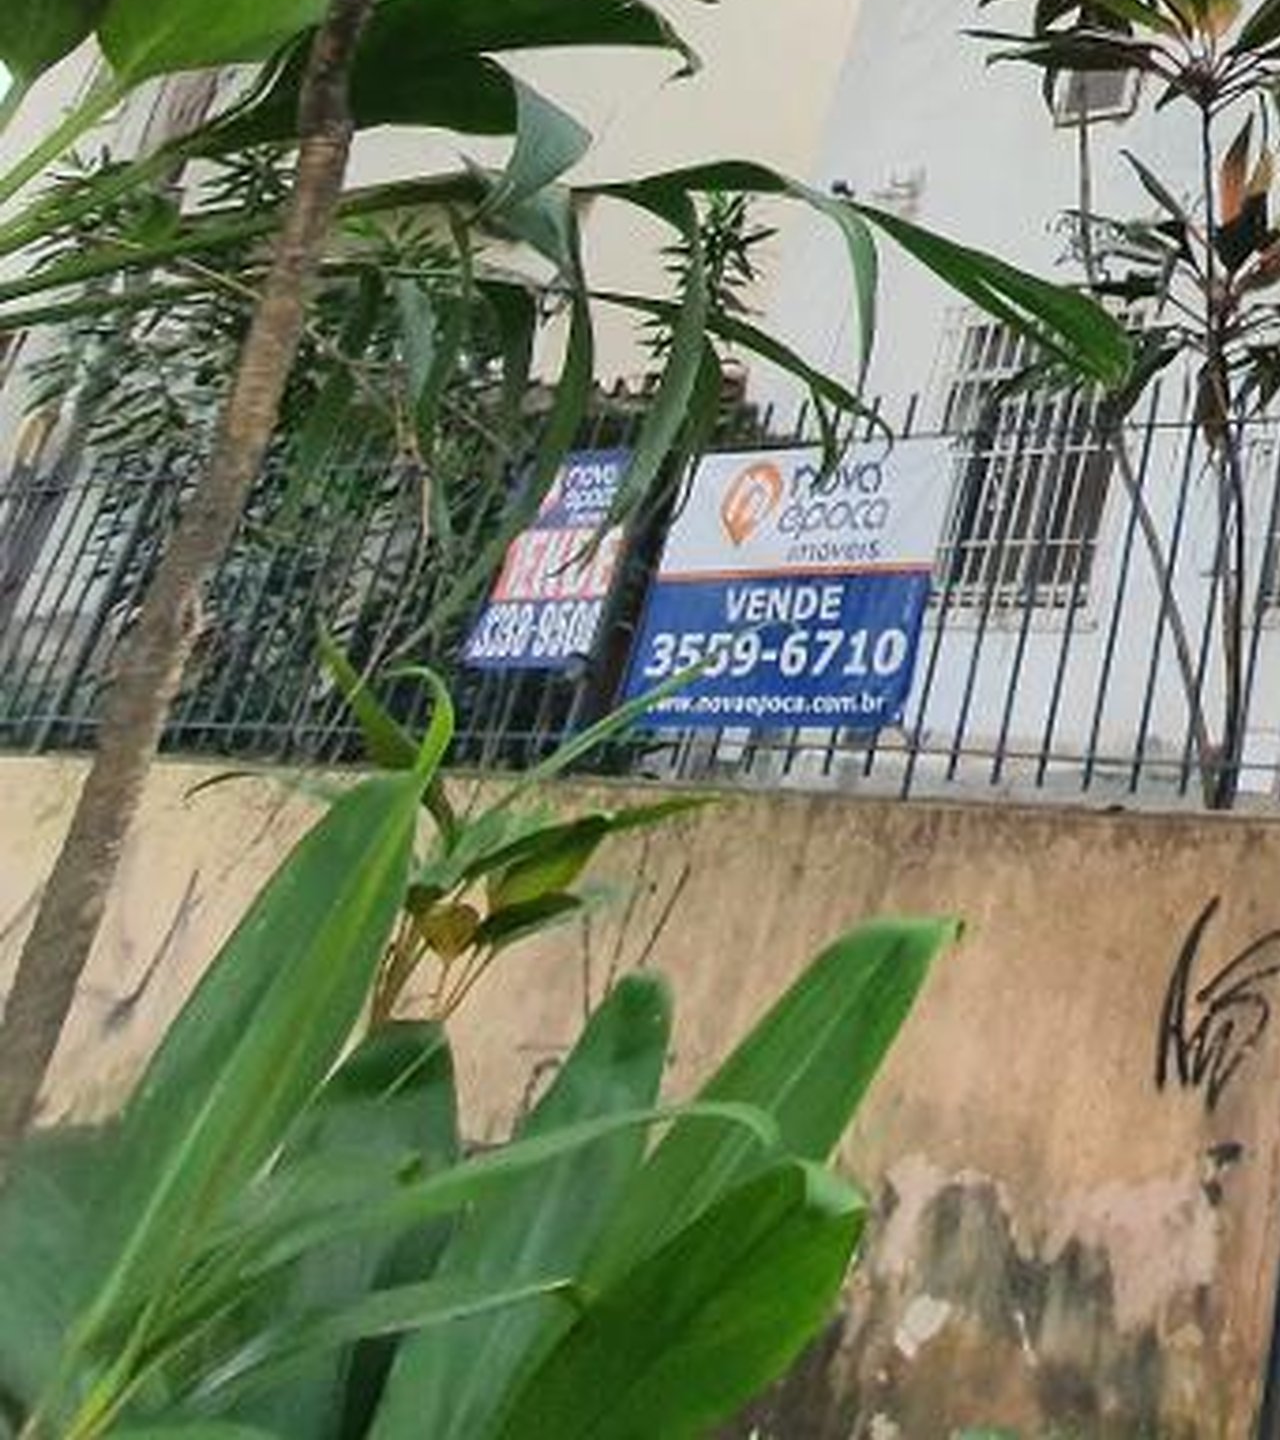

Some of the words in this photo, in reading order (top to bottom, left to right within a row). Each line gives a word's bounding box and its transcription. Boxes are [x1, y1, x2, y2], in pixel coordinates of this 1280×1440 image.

[790, 464, 882, 498] nova
[726, 586, 844, 622] VENDE
[643, 628, 908, 678] 3559-6710
